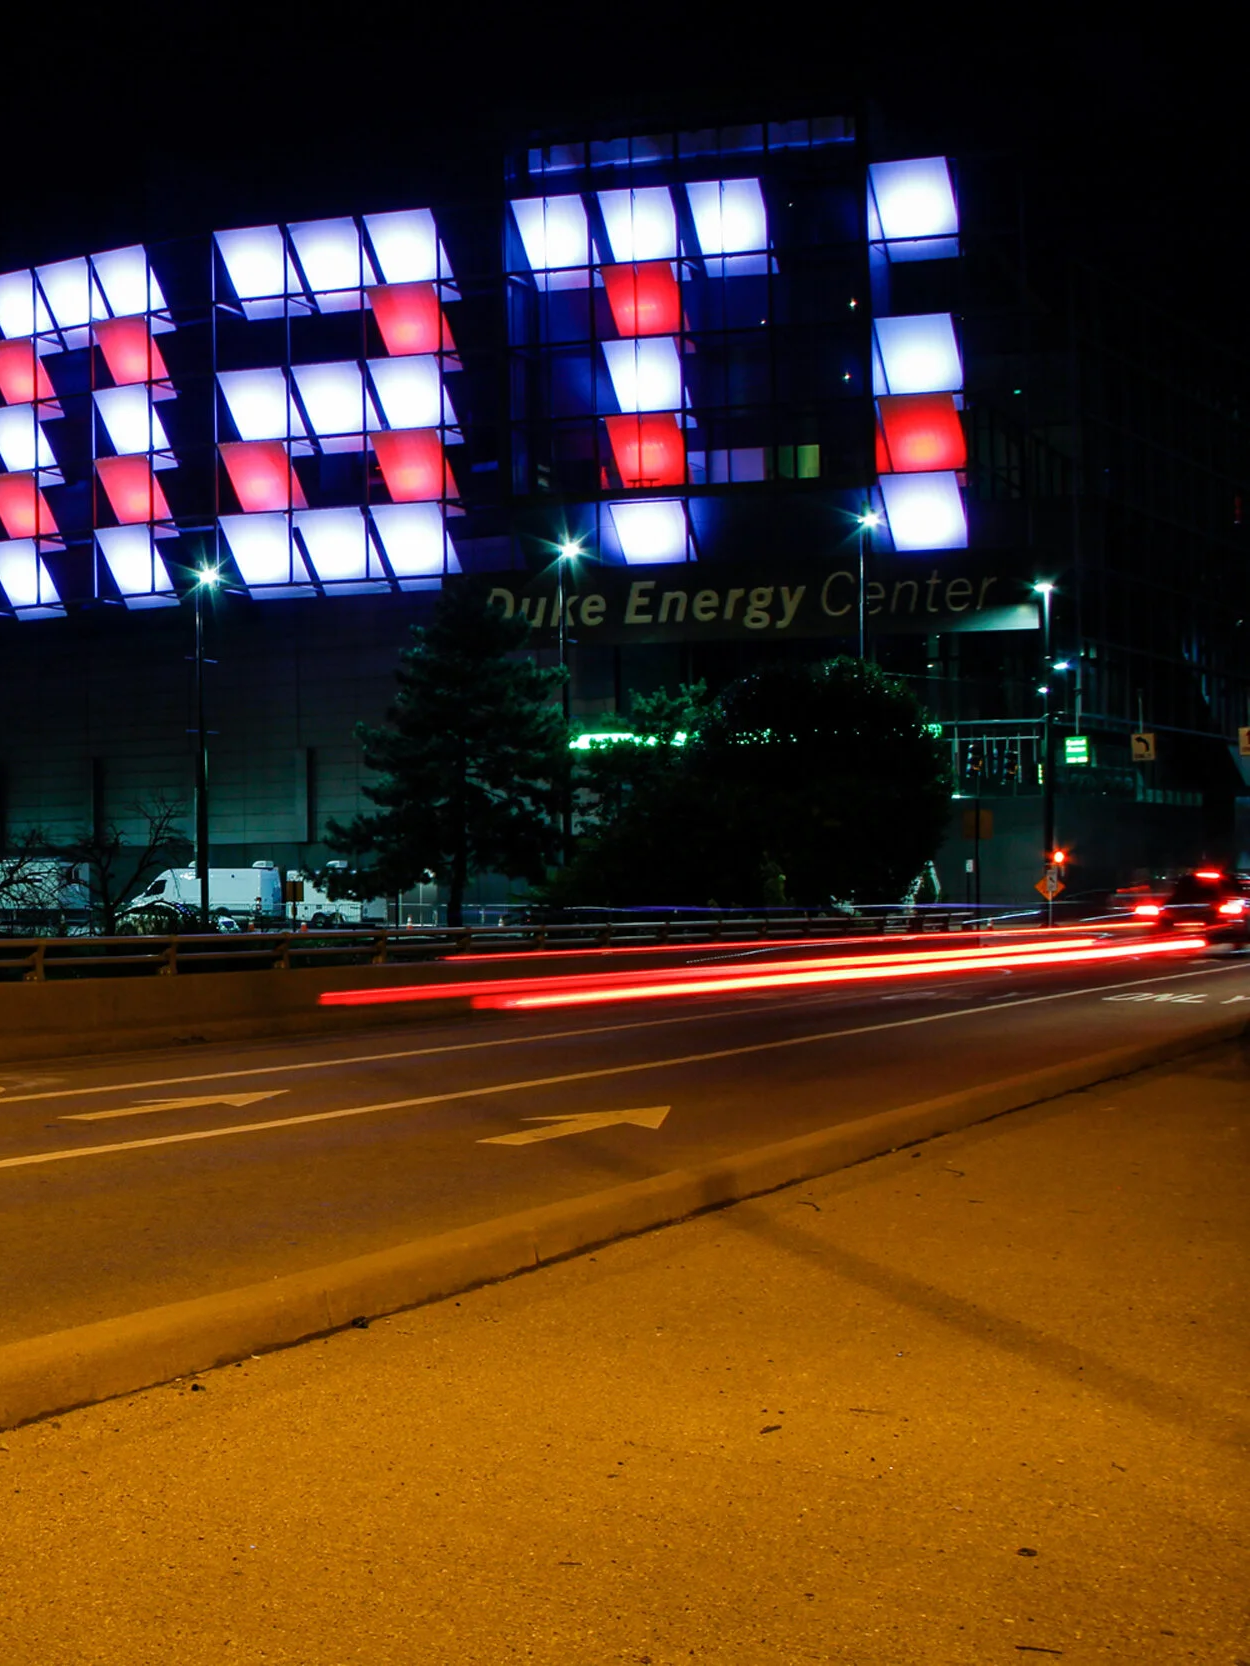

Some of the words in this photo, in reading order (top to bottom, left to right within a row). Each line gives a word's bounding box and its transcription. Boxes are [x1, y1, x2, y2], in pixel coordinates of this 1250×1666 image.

[488, 587, 607, 628] Duke
[624, 580, 806, 629] Energy
[820, 569, 998, 616] Center
